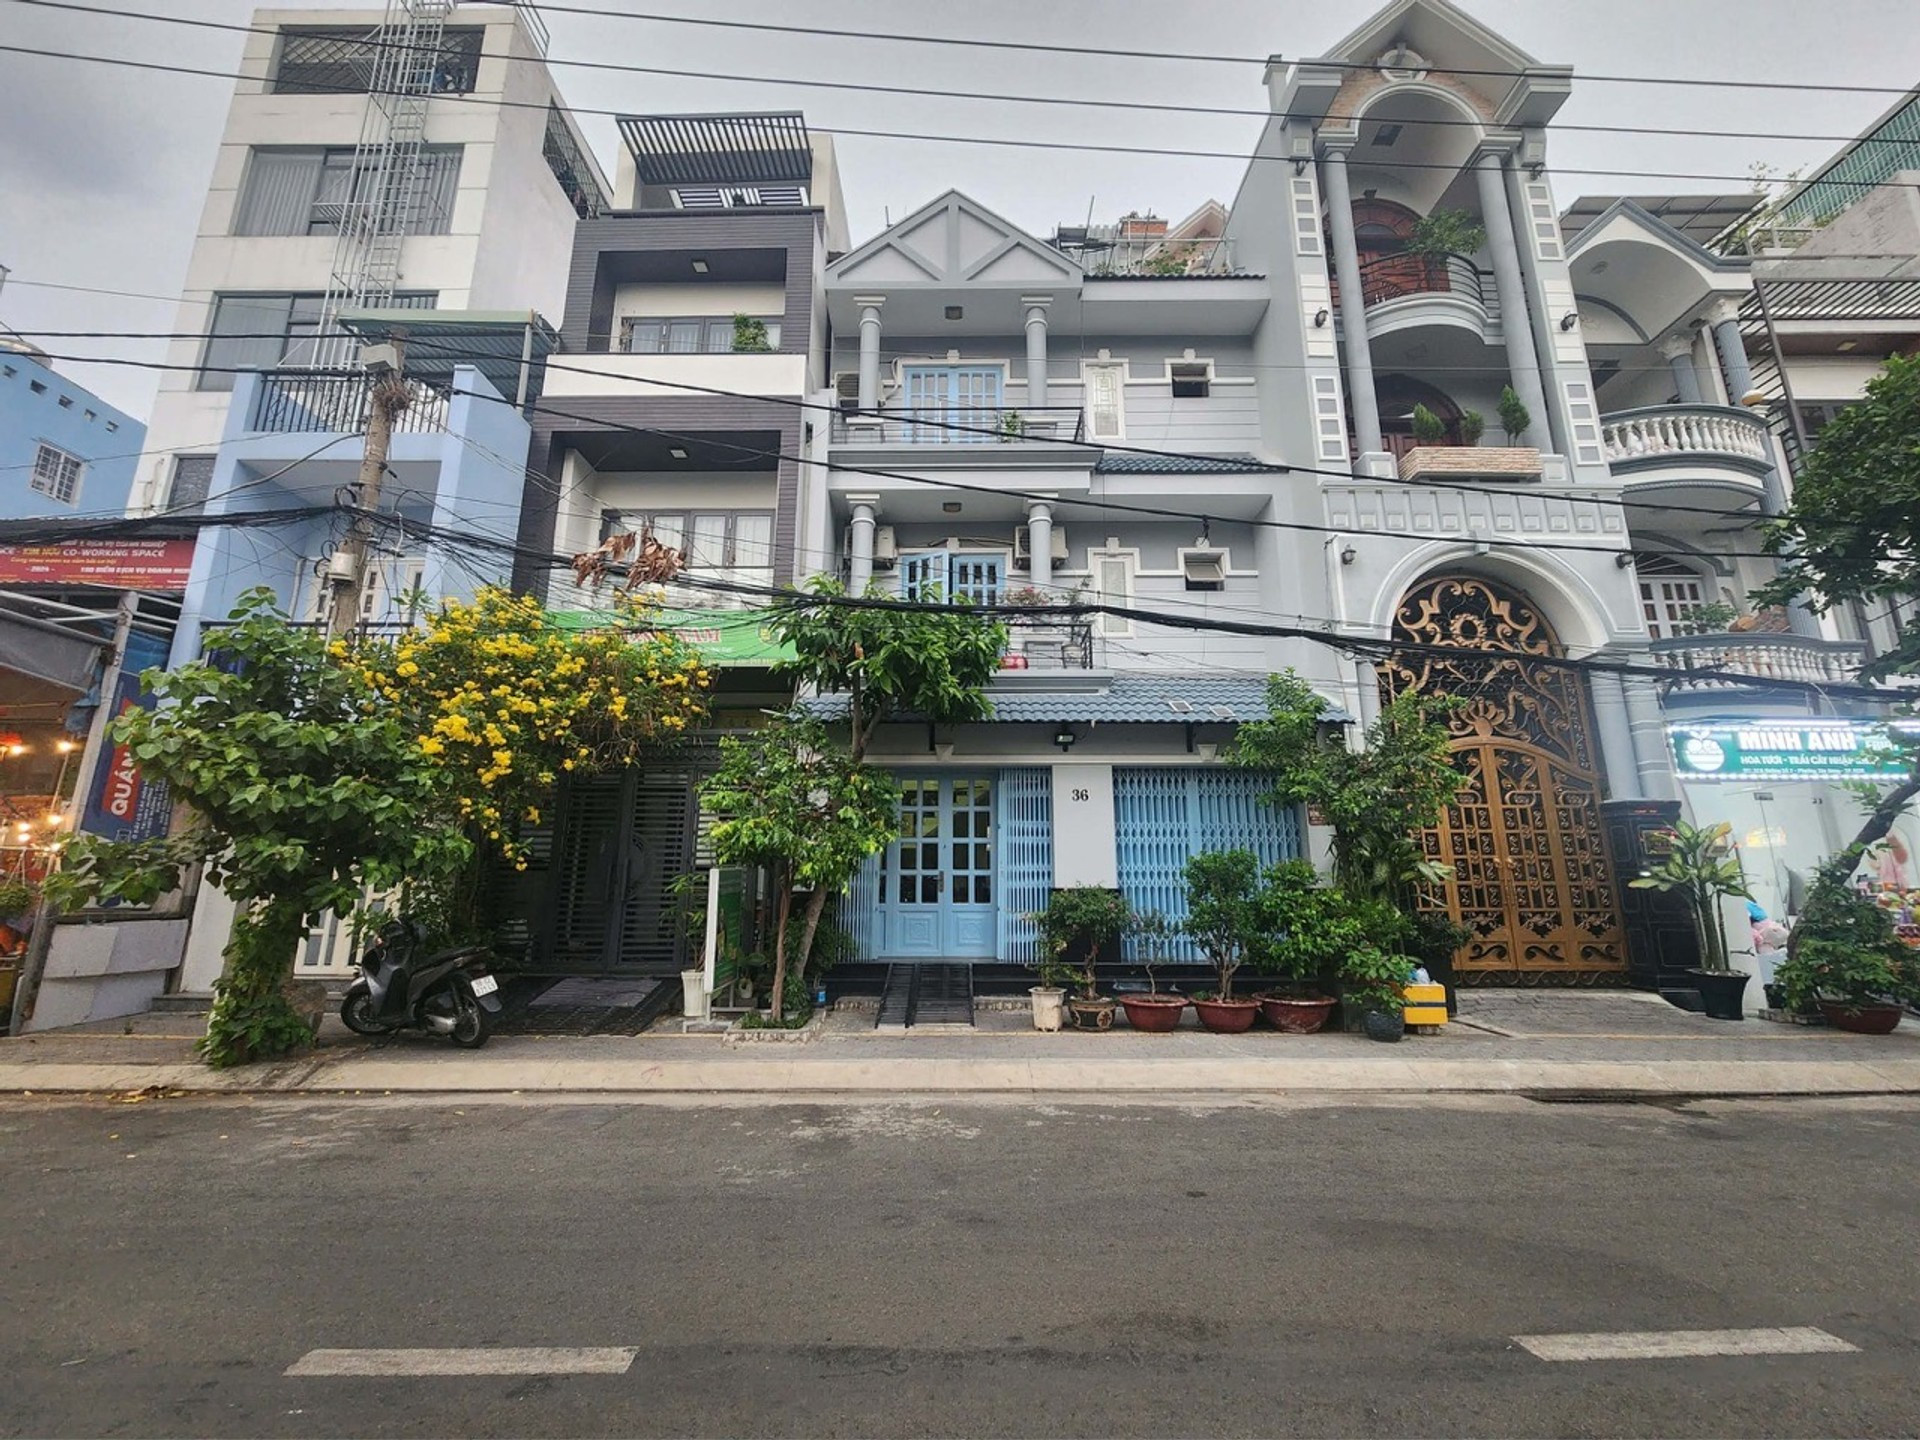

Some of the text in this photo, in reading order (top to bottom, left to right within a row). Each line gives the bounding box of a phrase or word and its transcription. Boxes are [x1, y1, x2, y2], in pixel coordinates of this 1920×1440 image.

[63, 548, 128, 557] CO-WORKING
[131, 549, 165, 557] SPACE
[1738, 731, 1803, 751] MINH
[1808, 731, 1857, 751] ANH
[1740, 755, 1761, 765] HOA
[1071, 788, 1090, 802] 36
